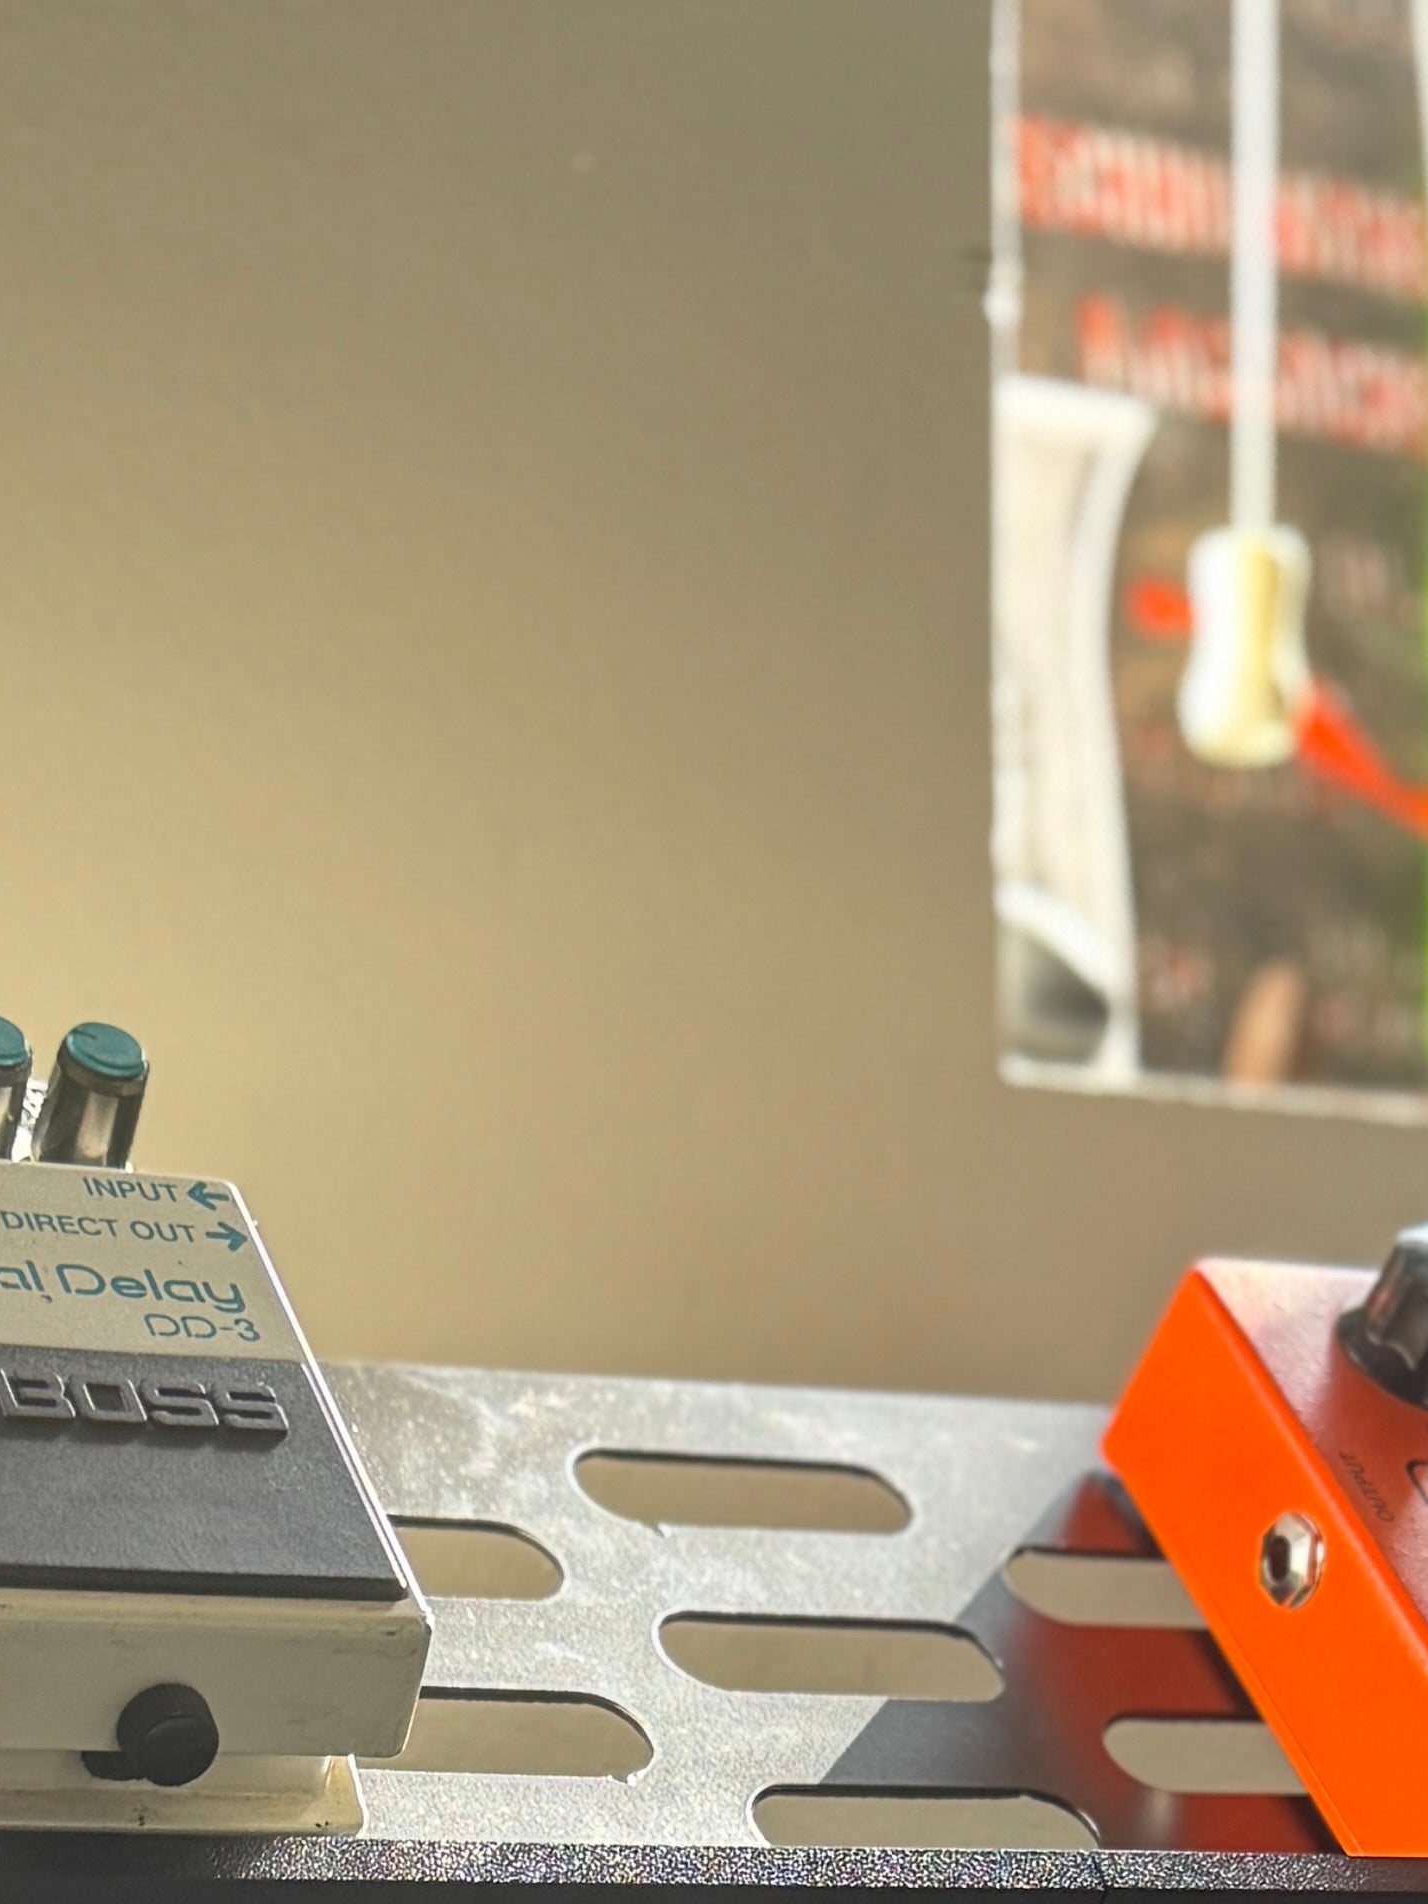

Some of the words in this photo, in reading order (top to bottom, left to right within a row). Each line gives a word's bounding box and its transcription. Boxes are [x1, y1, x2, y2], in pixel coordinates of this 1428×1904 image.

[83, 1176, 178, 1204] INPUT
[1, 1210, 116, 1239] DIRECT
[130, 1218, 195, 1244] OUT
[57, 1263, 245, 1313] Delay
[144, 1313, 260, 1341] DD-3
